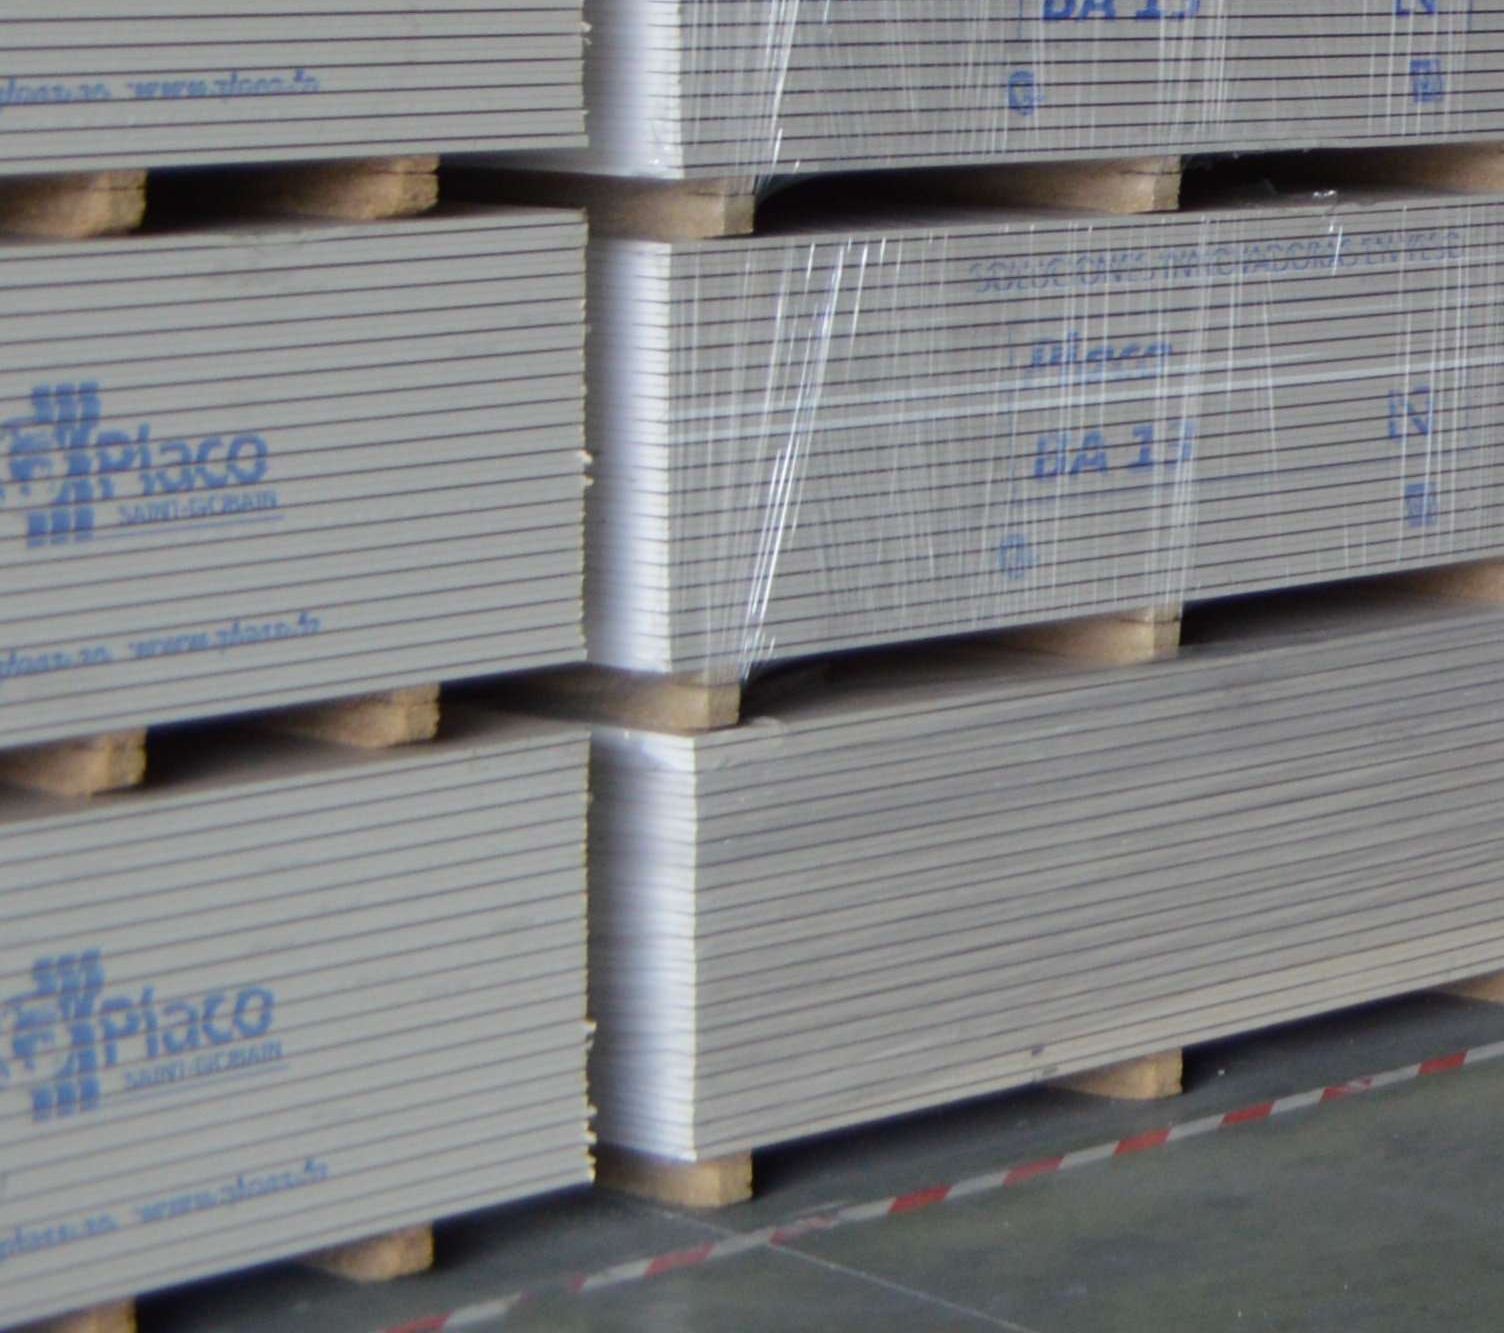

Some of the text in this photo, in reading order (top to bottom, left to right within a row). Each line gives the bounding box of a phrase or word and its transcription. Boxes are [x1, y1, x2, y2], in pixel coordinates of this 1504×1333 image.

[970, 250, 1150, 296] SOLUCIONES
[1158, 234, 1358, 282] INNOVADORAS
[97, 423, 269, 496] Placo
[1033, 418, 1197, 481] BA 13
[118, 489, 280, 530] SAINT-GOBAIN
[100, 984, 276, 1052] Placo
[122, 1040, 285, 1092] SAINT-GOBAIN
